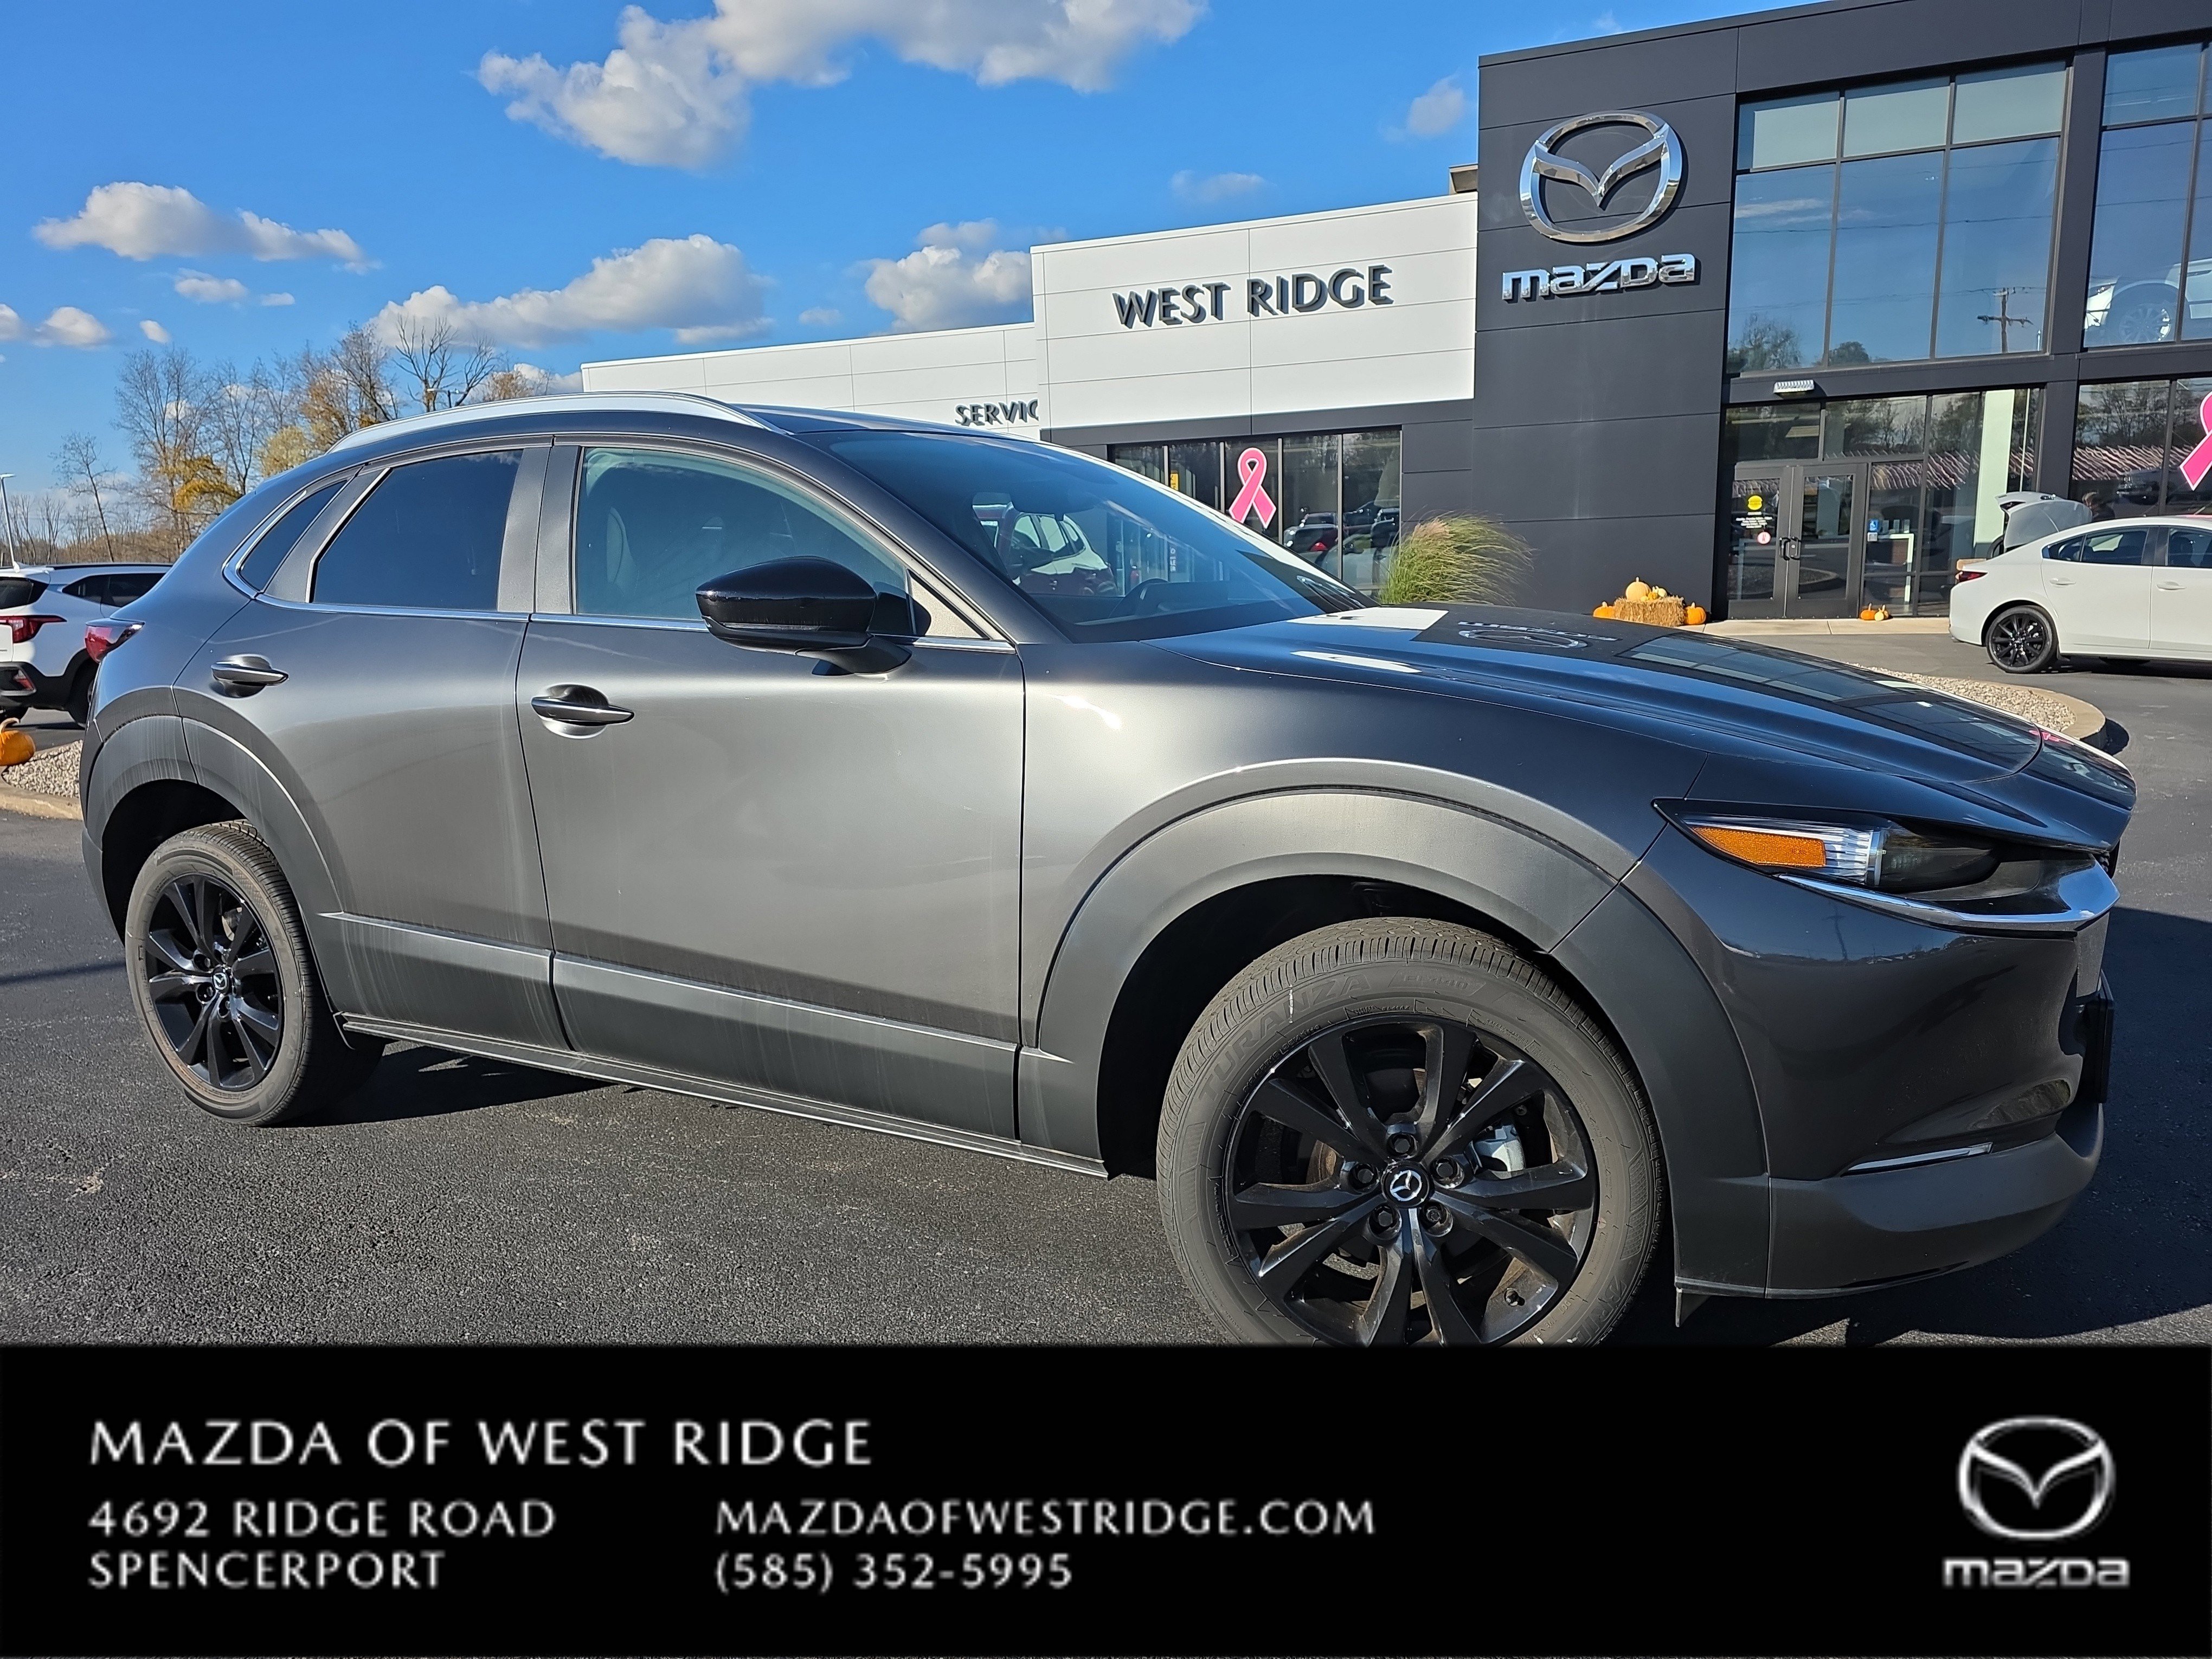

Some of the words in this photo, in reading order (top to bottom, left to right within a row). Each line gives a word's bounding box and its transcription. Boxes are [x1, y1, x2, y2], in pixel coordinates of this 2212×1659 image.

[1112, 282, 1231, 329] WEST
[1247, 265, 1394, 317] RIDGE
[955, 398, 1039, 427] SERVIC
[1198, 973, 1372, 1102] TURANZA
